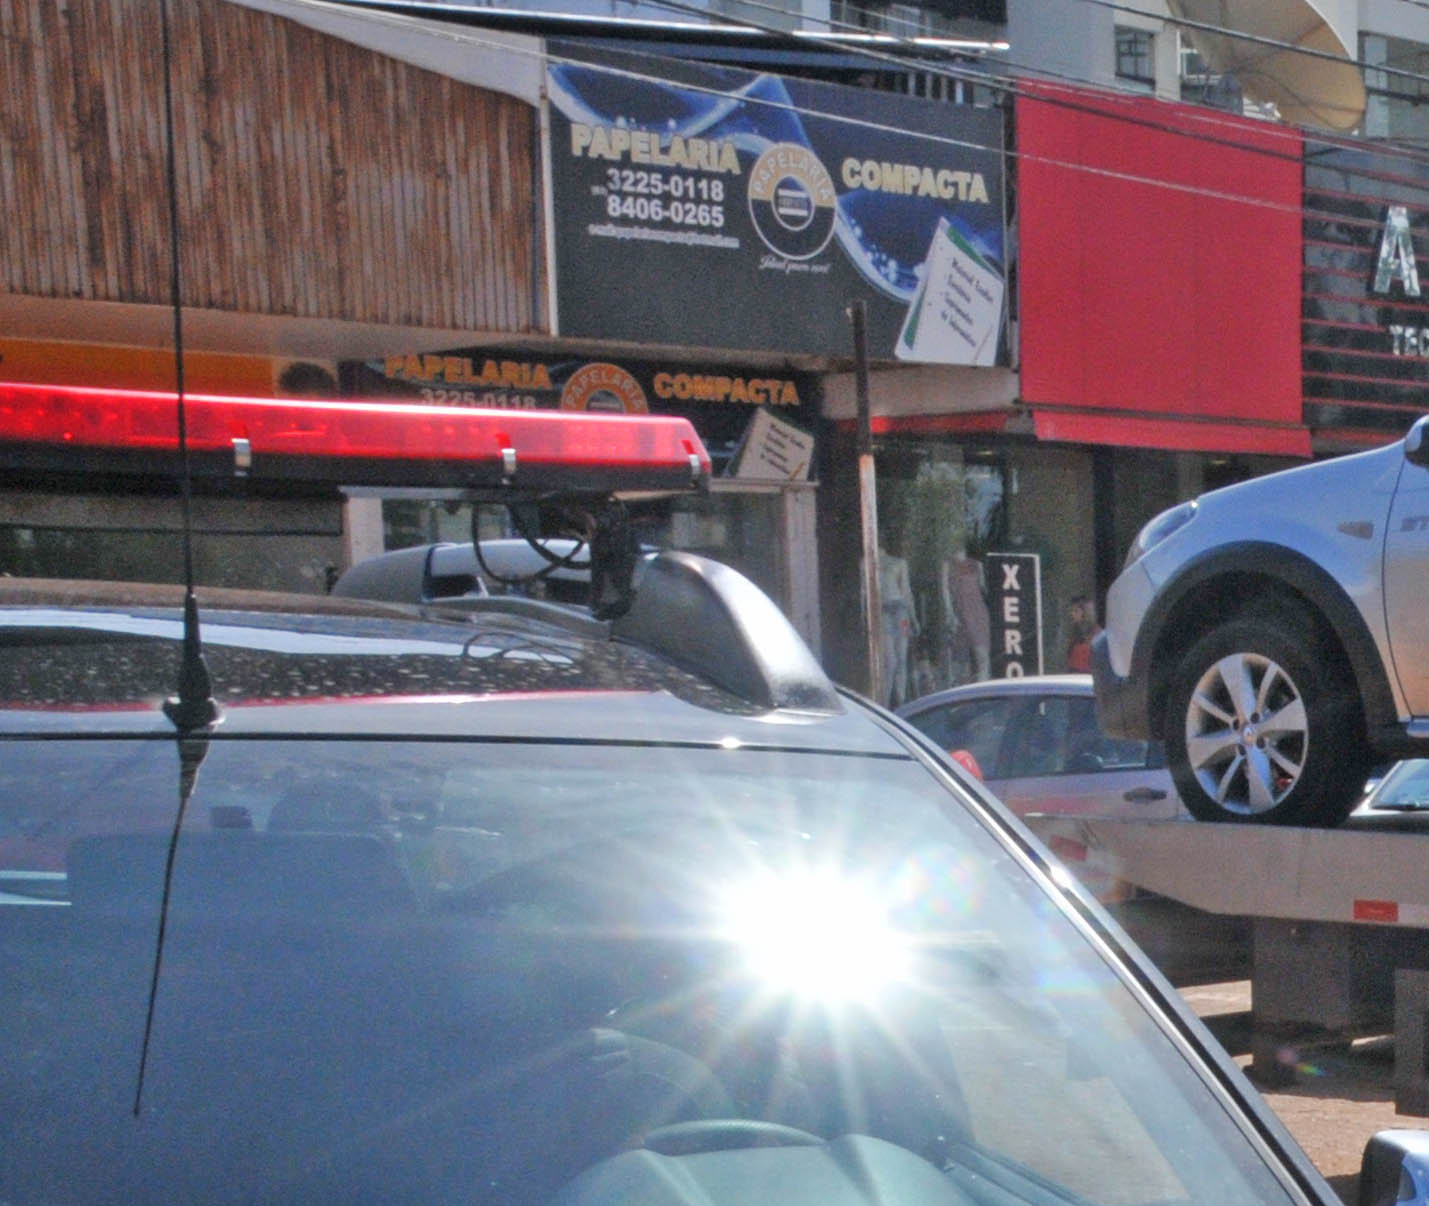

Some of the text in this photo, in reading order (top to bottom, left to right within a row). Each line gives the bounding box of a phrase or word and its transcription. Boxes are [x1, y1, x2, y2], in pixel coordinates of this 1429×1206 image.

[571, 123, 990, 204] PAPELARIA COMPACTA
[606, 168, 724, 202] 3225-0118
[606, 195, 724, 228] 8406-0265
[1374, 205, 1421, 297] A
[384, 354, 800, 406] PAPELARIA COMPACTA
